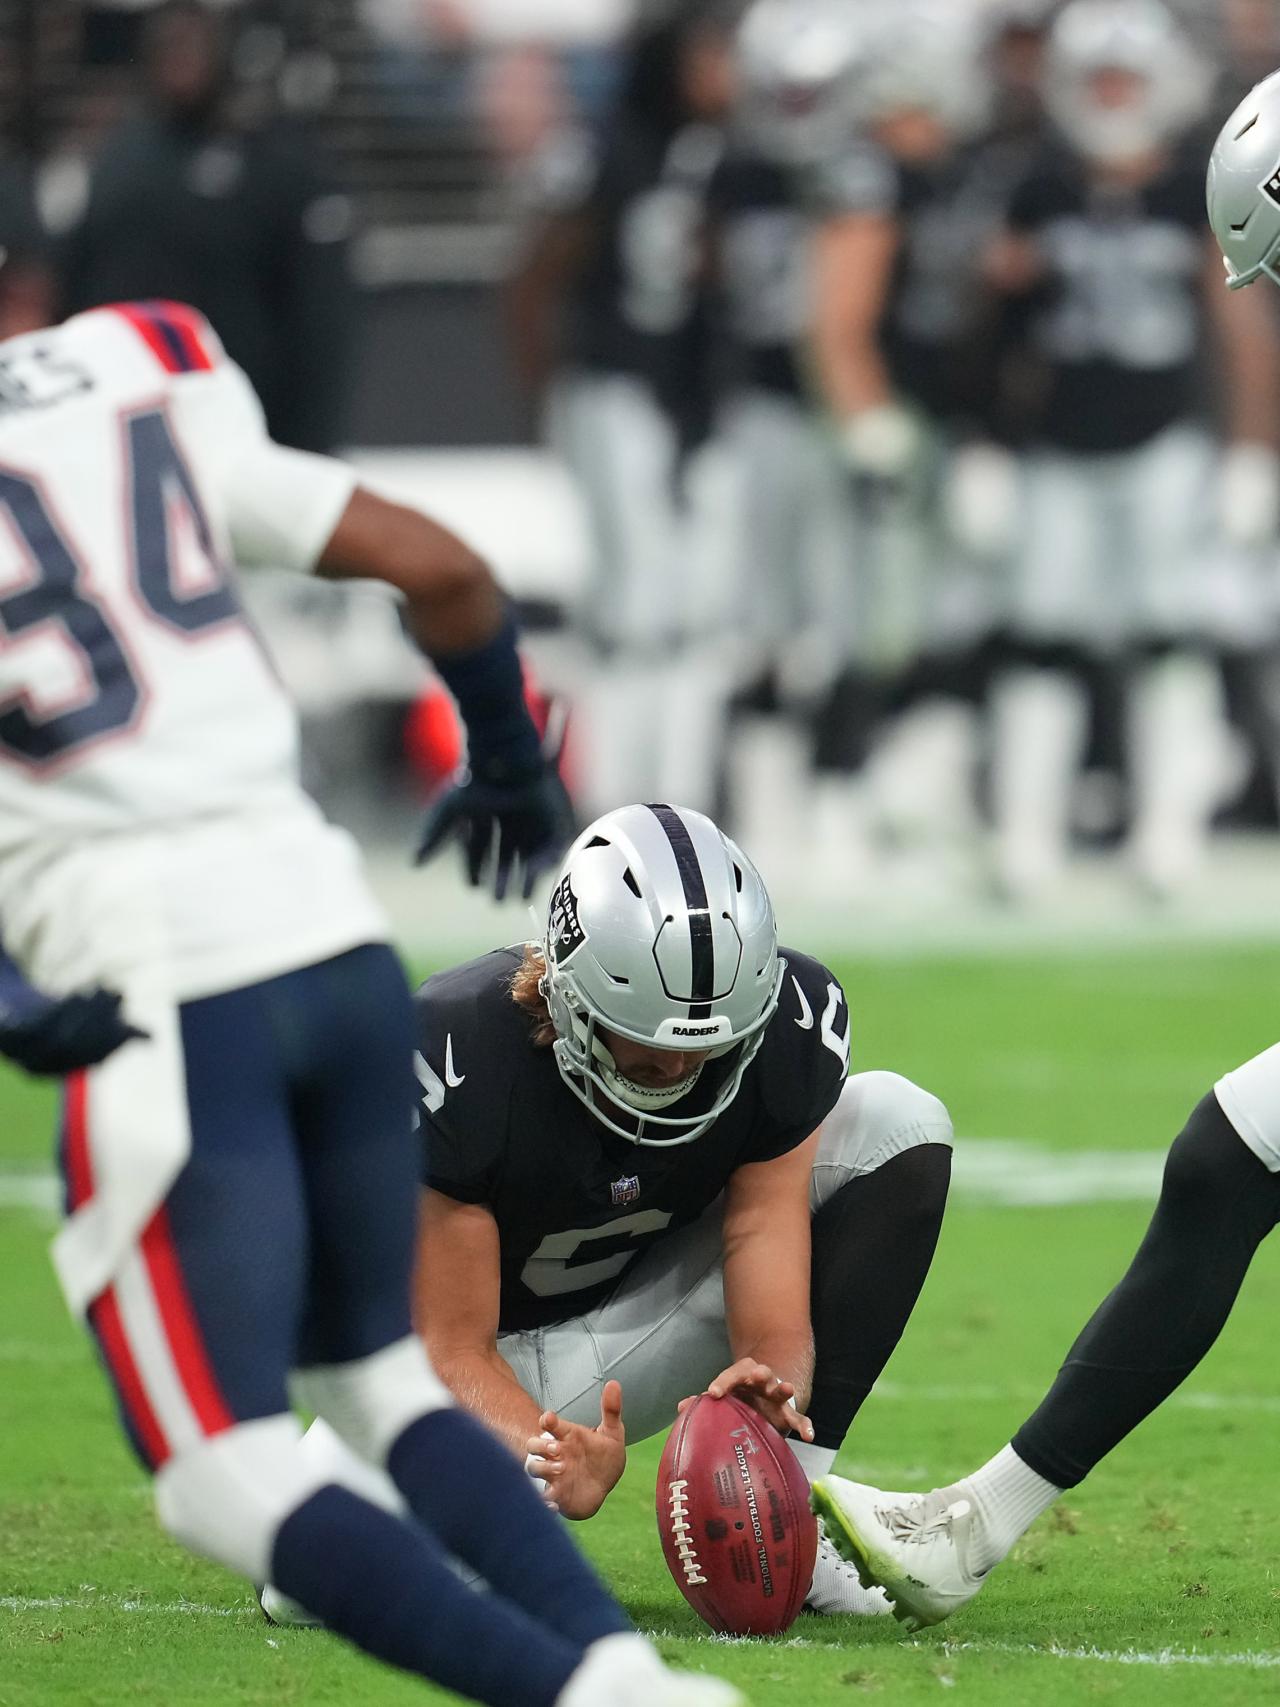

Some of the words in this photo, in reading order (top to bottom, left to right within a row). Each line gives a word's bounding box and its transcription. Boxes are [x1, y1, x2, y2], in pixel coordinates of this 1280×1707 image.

[562, 879, 581, 938] RAIDERS
[672, 1025, 720, 1036] RAIDERS
[734, 1444, 751, 1484] LEAGUE
[745, 1487, 763, 1543] FOOTBALL
